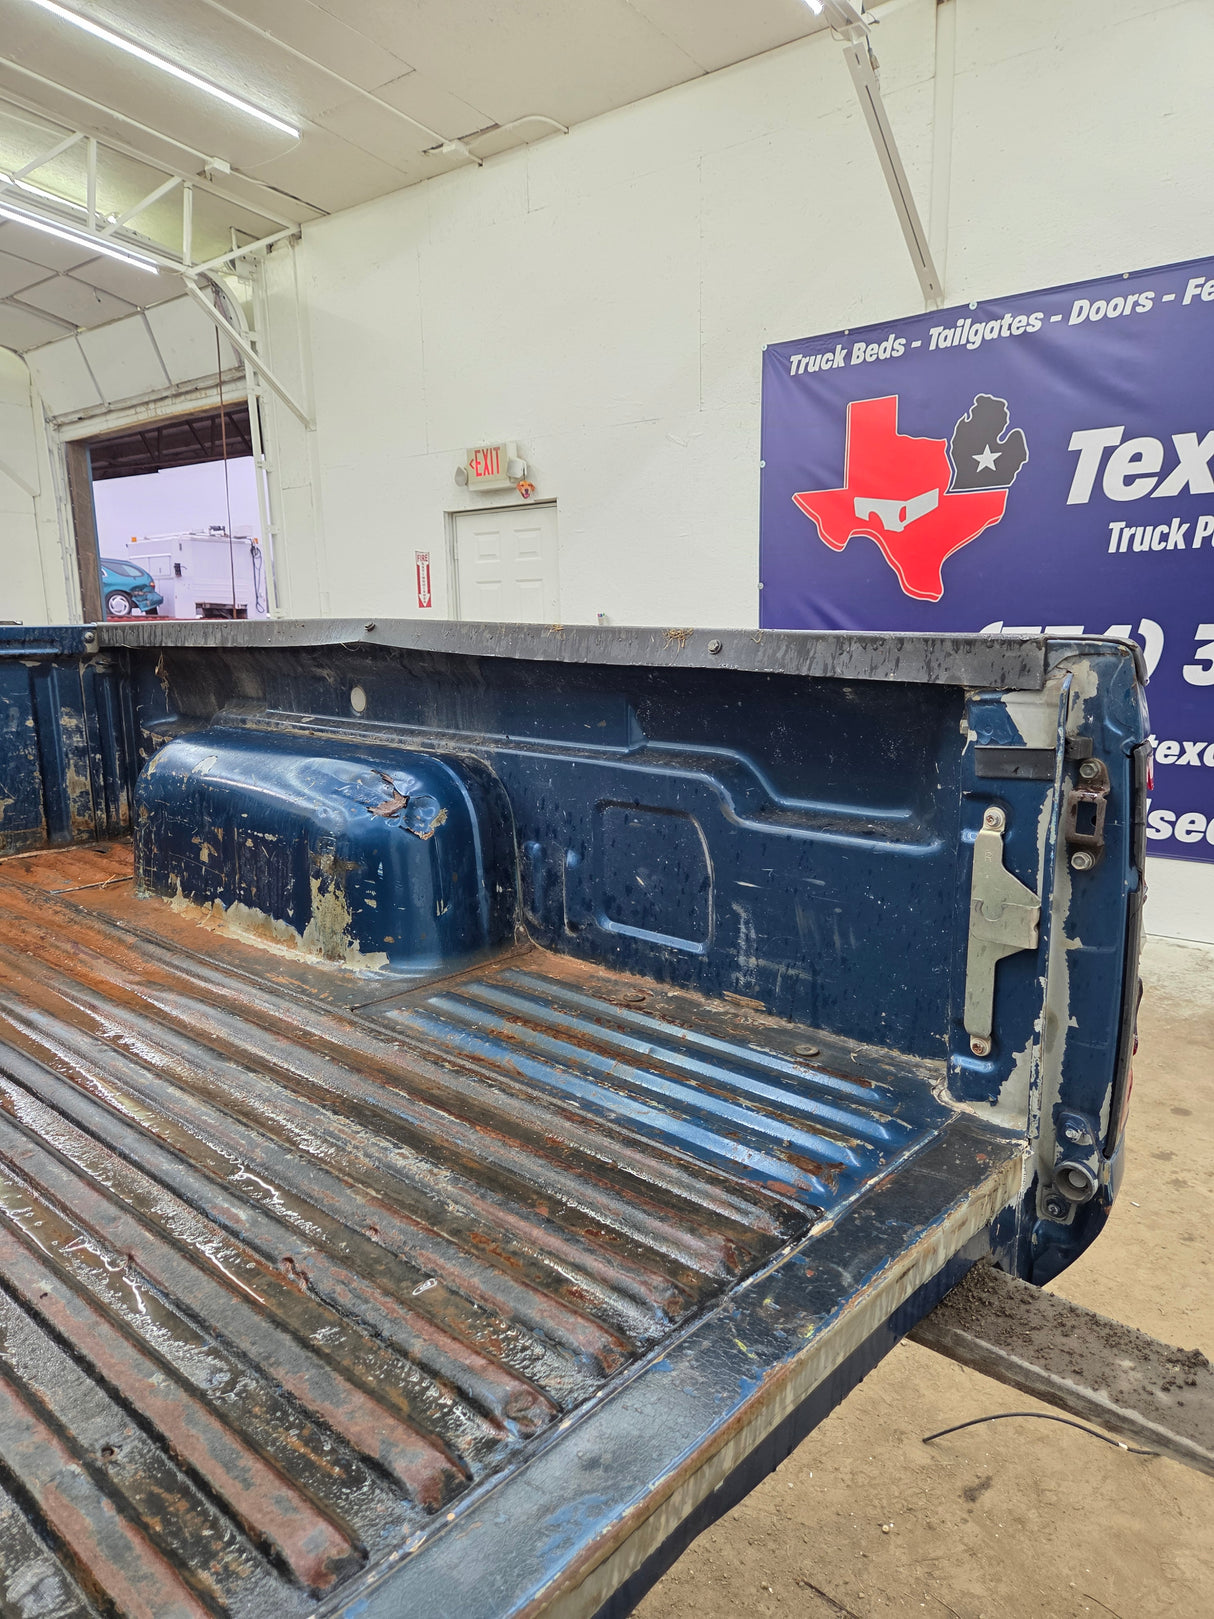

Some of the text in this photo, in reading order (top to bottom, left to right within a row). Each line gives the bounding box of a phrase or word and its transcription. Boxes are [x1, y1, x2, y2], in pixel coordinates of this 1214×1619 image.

[789, 344, 848, 376] Truck
[850, 333, 907, 365] Beds
[910, 339, 922, 349] -
[929, 312, 1044, 351] Tailgates
[1049, 314, 1063, 323] -
[1068, 291, 1155, 326] Doors
[1161, 293, 1176, 302] -
[474, 446, 501, 477] EXIT
[1066, 425, 1214, 505] Tex
[1107, 515, 1214, 554] Truck P
